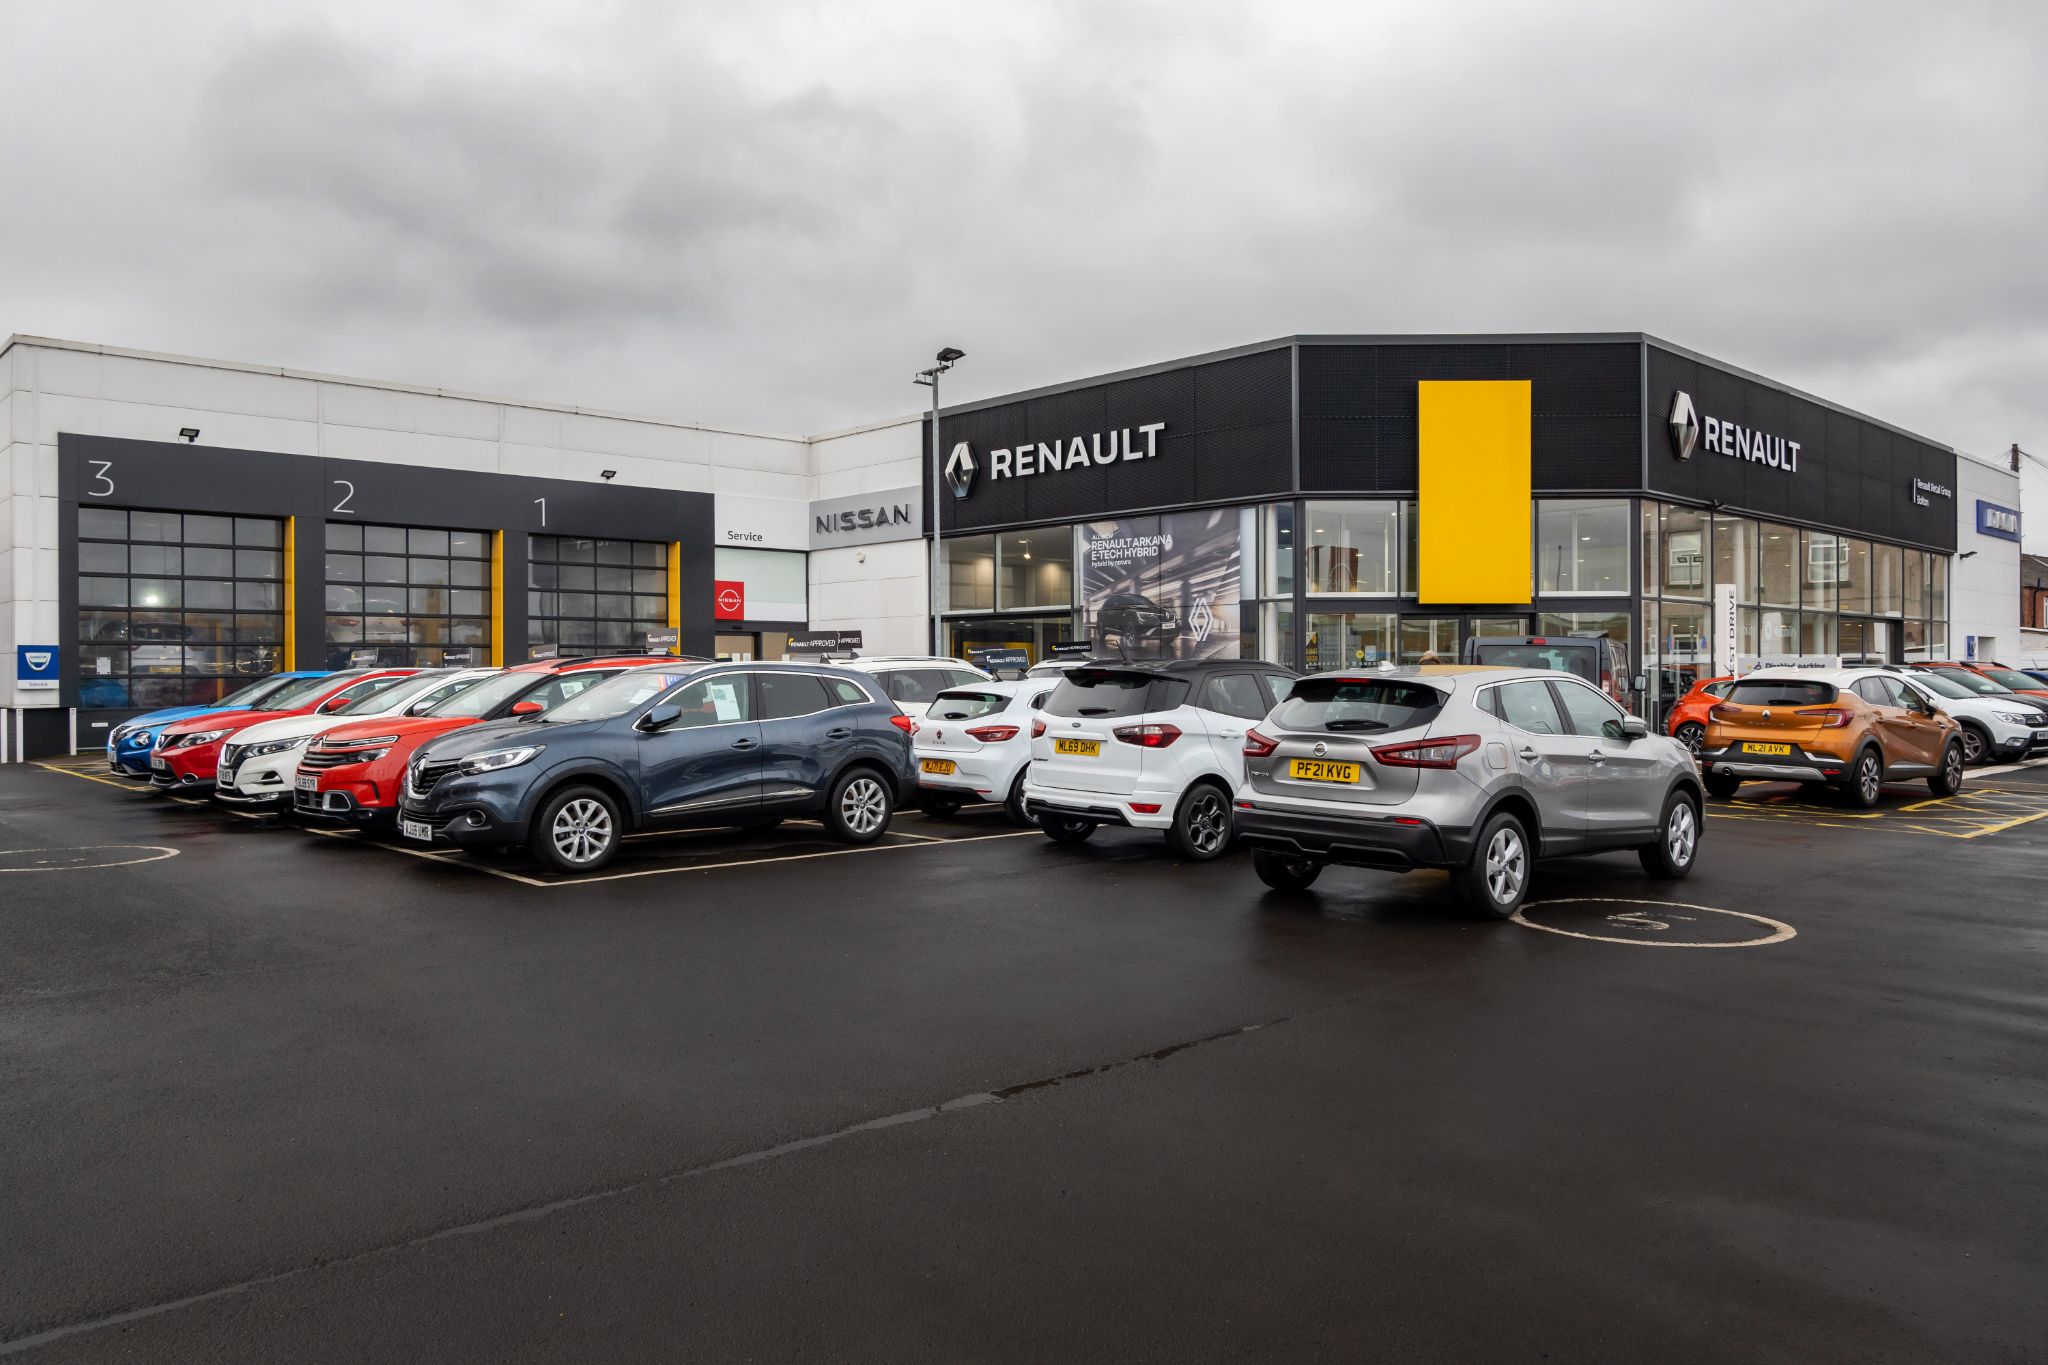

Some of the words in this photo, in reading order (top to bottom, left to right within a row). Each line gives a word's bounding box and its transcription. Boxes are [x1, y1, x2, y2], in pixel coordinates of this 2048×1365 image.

[990, 422, 1165, 480] RENAULT
[1704, 415, 1801, 473] RENAULT
[87, 460, 115, 497] 3
[332, 480, 355, 513] 2
[1917, 478, 1931, 492] Renault
[1931, 482, 1941, 494] Retail
[1941, 486, 1951, 500] Group
[1916, 495, 1930, 507] Bolton
[534, 498, 546, 527] 1
[816, 503, 912, 534] NISSAN
[727, 530, 763, 542] Service
[1091, 538, 1132, 551] RENAULT
[1132, 534, 1173, 547] ARKANA
[1091, 549, 1123, 561] E-TECH
[1124, 546, 1159, 557] HYBRID
[809, 639, 836, 647] APPROVED
[1058, 741, 1079, 753] ML69
[1080, 742, 1096, 754] DHK
[1747, 744, 1766, 752] ML21
[1768, 745, 1785, 753] AVK
[1297, 762, 1324, 776] PF21
[1327, 763, 1351, 779] KVG
